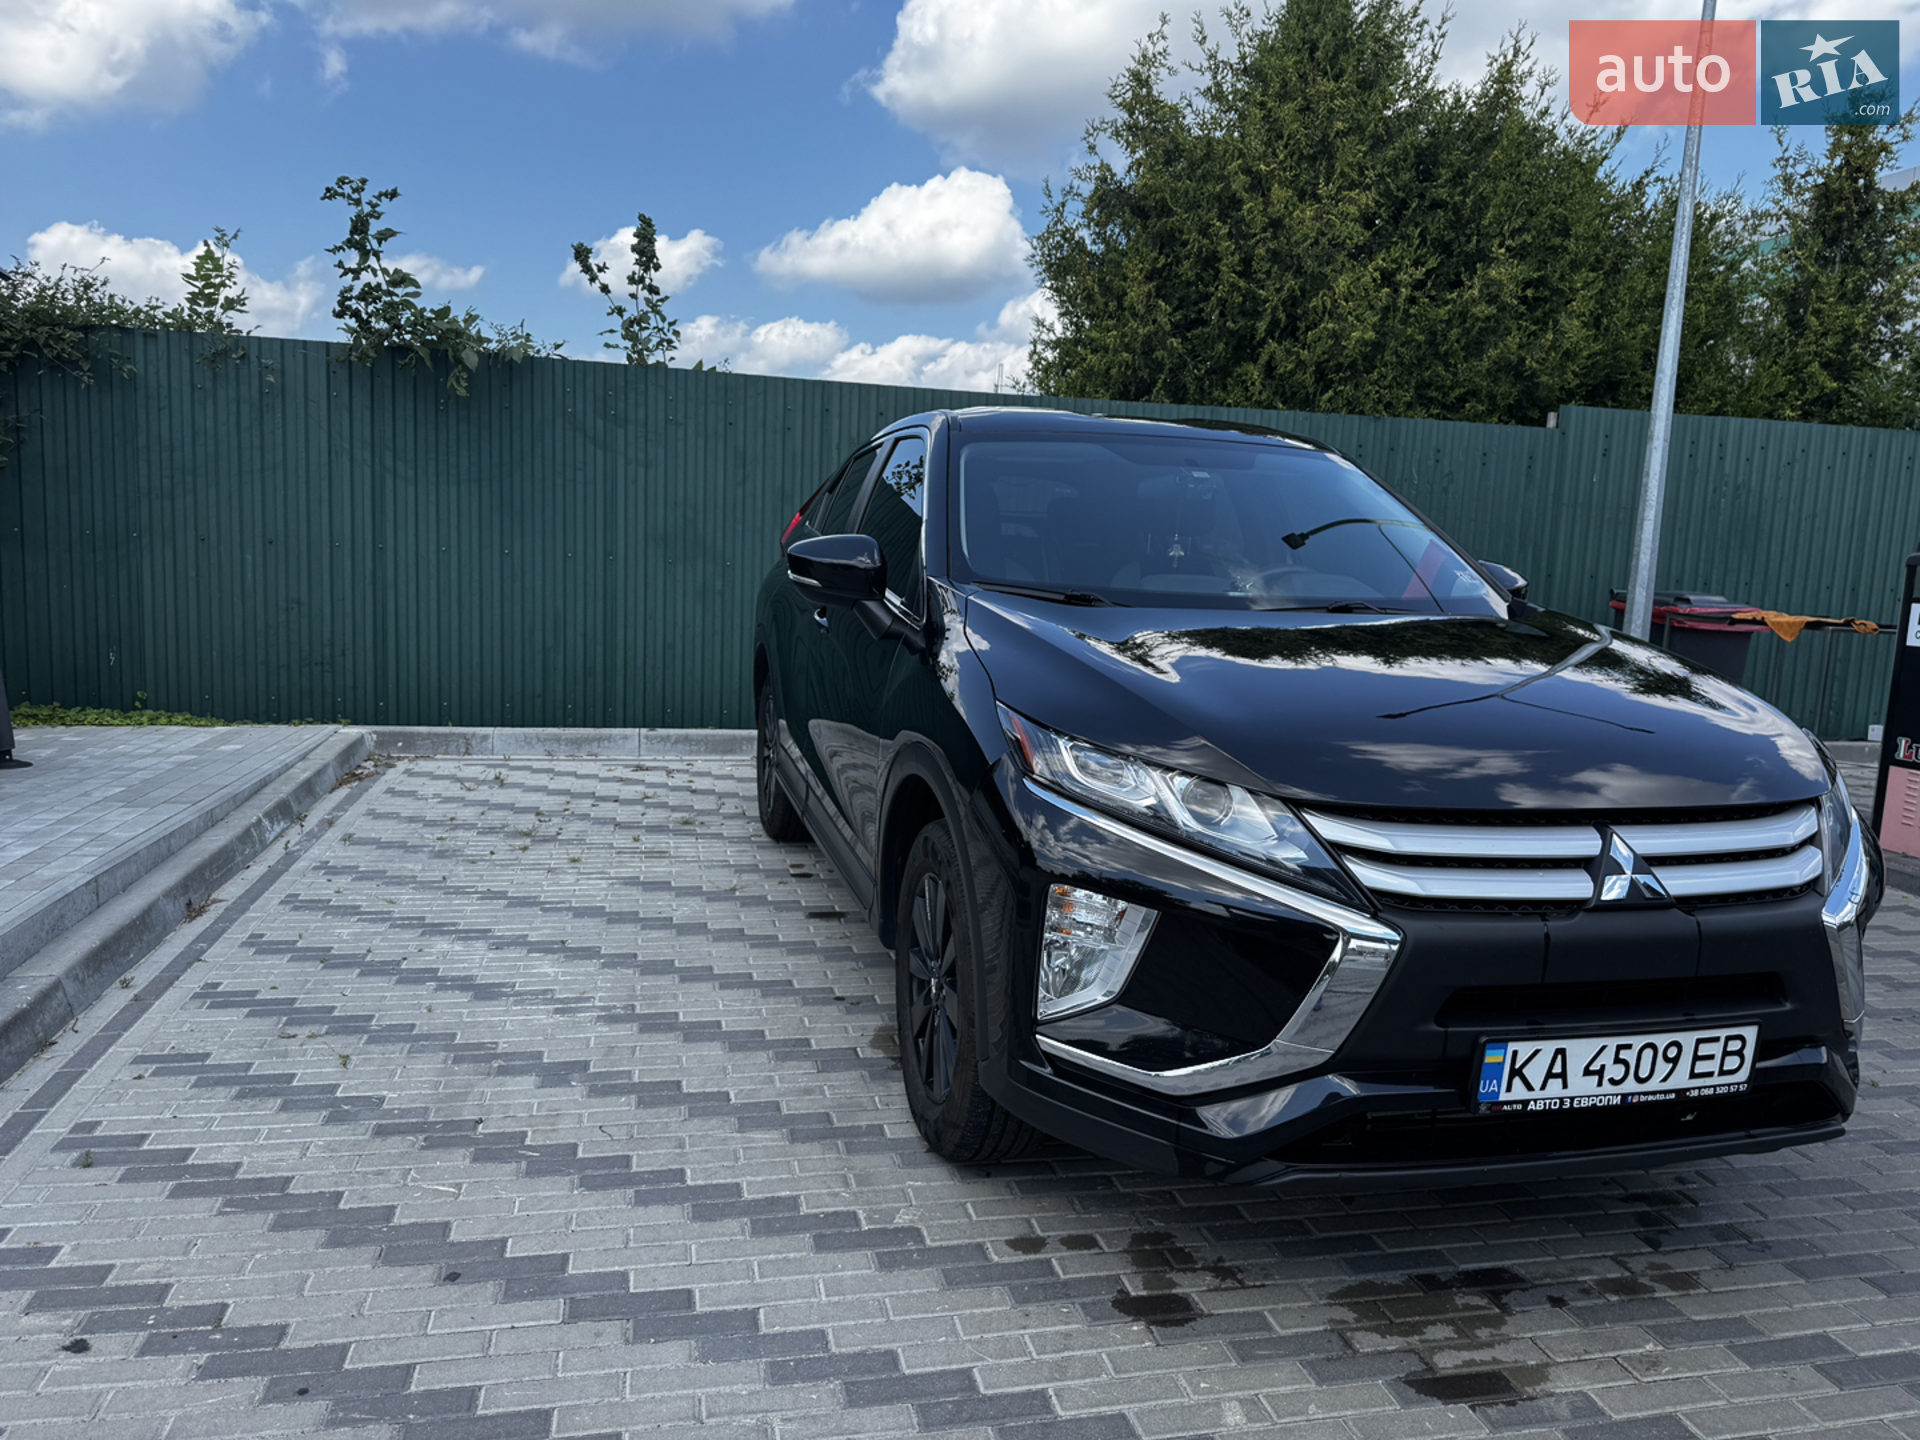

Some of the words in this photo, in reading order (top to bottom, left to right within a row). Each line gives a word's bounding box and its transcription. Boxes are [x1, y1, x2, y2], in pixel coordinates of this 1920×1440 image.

[1505, 1047, 1569, 1093] KA
[1582, 1039, 1684, 1088] 4509
[1688, 1034, 1747, 1080] EB
[1479, 1079, 1499, 1093] UA
[1527, 1099, 1560, 1111] АВТО
[1573, 1095, 1622, 1108] ЄВРОПИ
